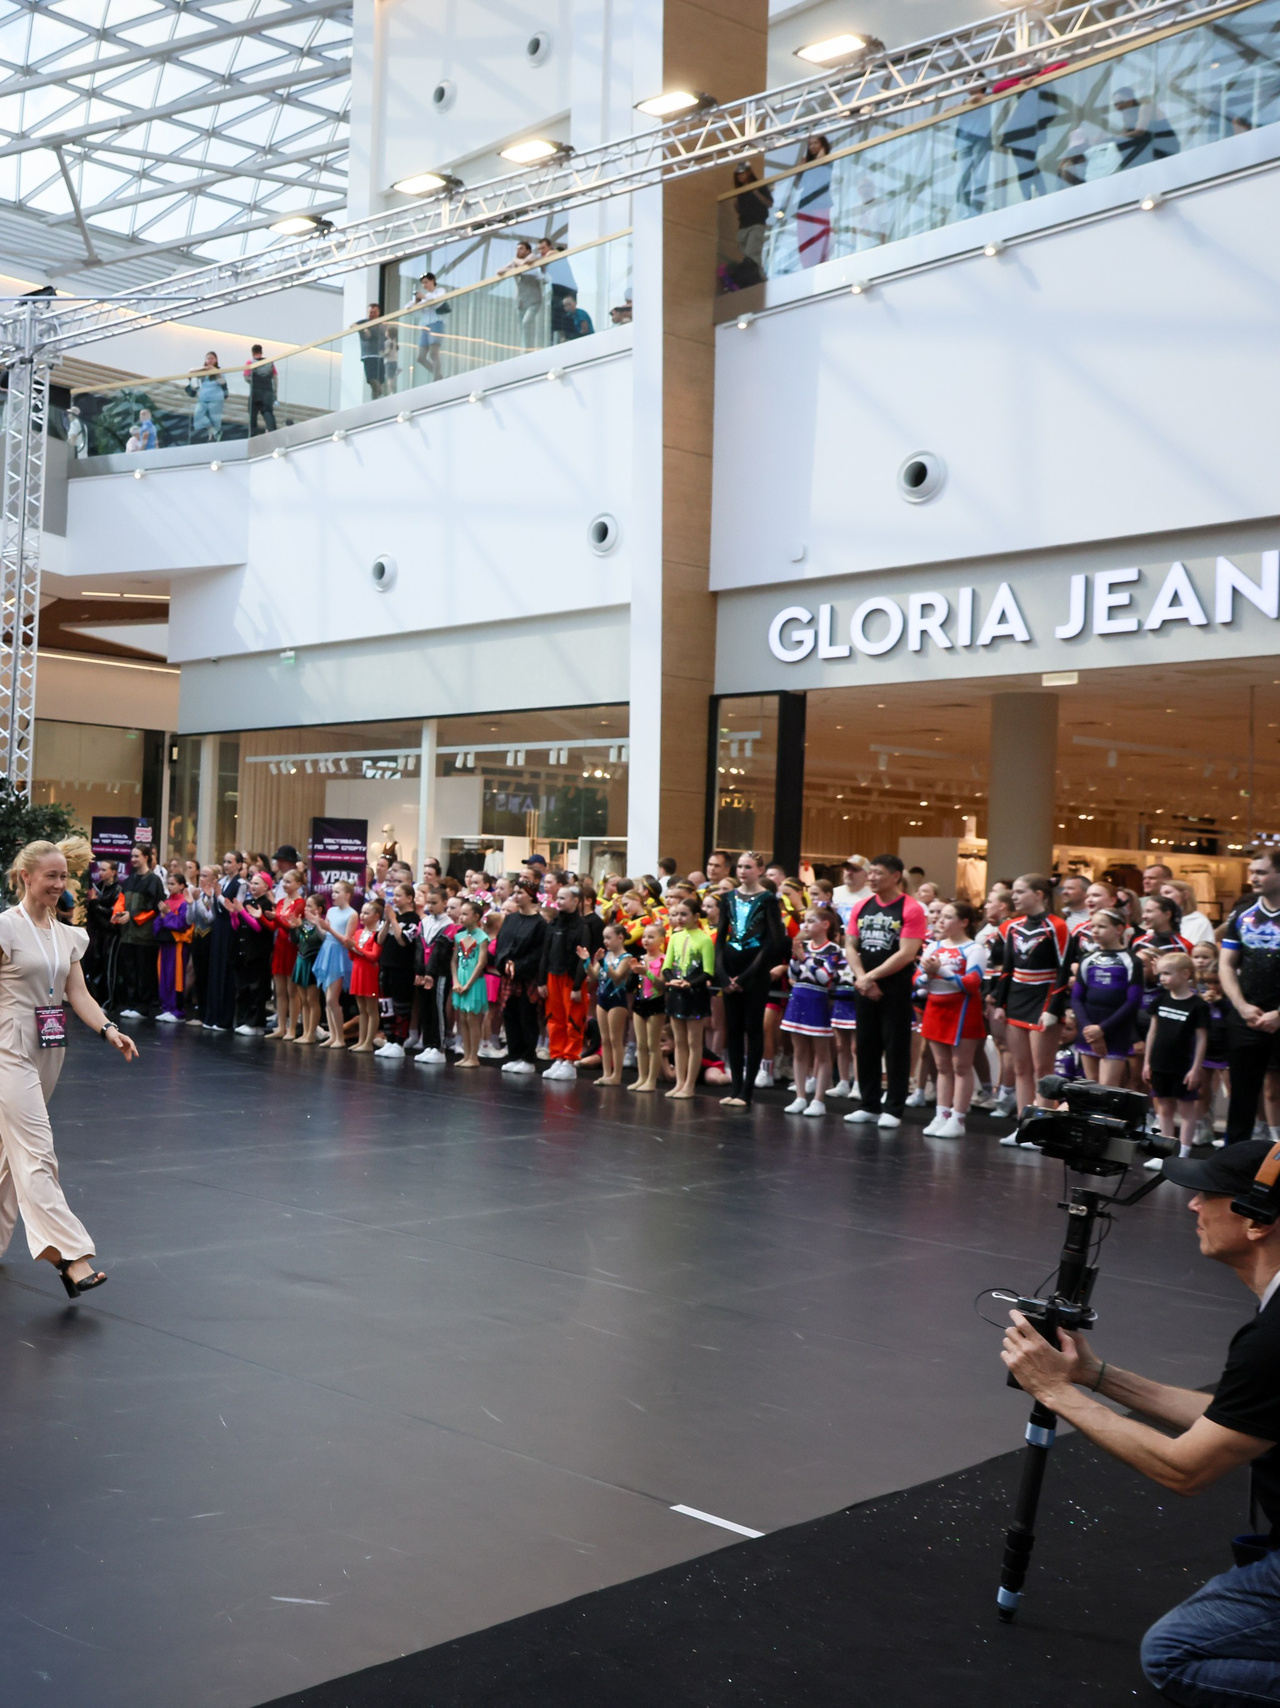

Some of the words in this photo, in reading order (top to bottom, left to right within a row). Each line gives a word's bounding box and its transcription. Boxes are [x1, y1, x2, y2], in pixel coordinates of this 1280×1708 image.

[768, 581, 1031, 664] GLORIA
[1055, 549, 1280, 640] JEAN
[320, 870, 359, 884] УРАЛ
